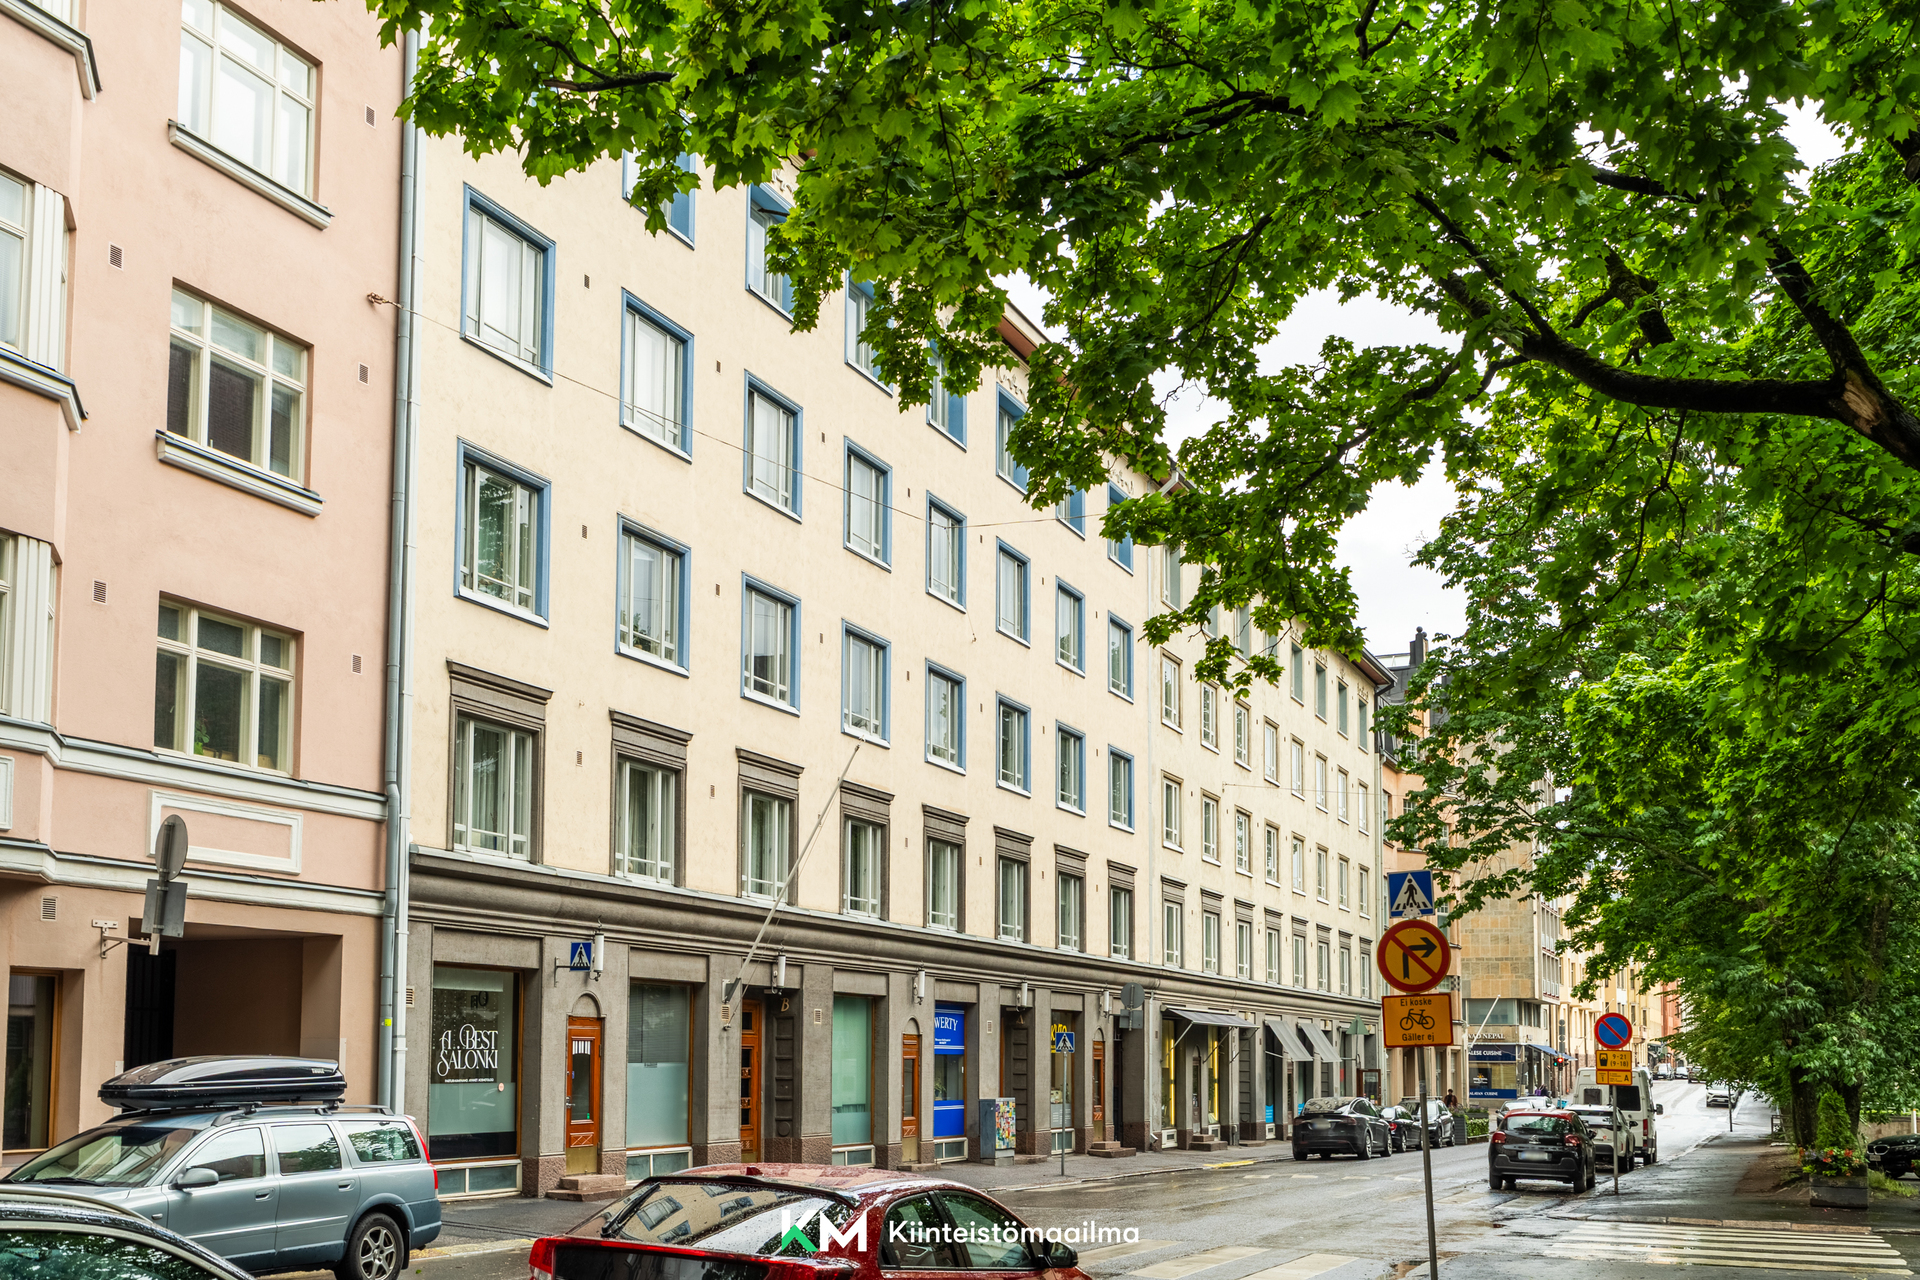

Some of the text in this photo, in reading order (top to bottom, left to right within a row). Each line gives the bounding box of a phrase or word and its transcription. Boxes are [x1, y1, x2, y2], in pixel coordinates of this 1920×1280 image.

[781, 998, 790, 1011] B
[1401, 998, 1432, 1006] Ei koske
[459, 1024, 499, 1050] BEST
[1402, 1032, 1435, 1042] Gäller ej
[437, 1049, 499, 1077] SALONKI
[1624, 1074, 1630, 1082] A
